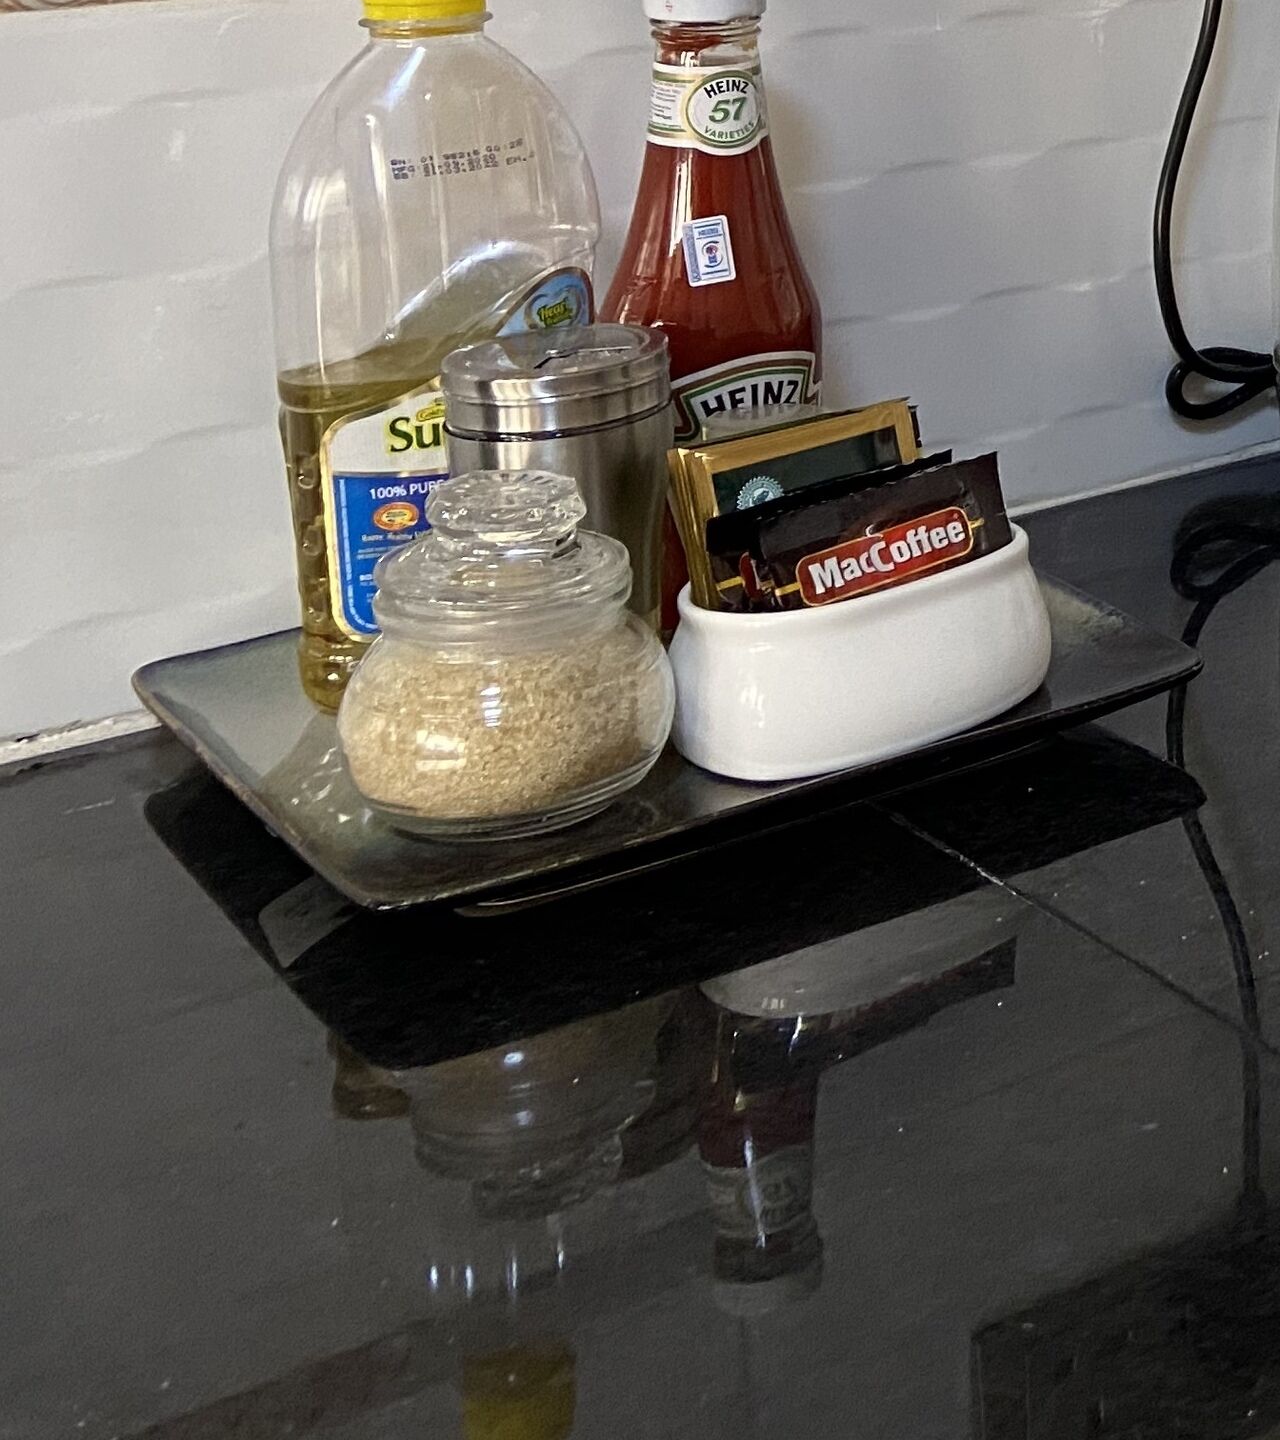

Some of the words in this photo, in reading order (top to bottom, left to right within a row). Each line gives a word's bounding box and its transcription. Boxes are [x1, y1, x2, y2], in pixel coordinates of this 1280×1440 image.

[704, 79, 749, 99] HEINZ
[708, 97, 746, 123] 57
[704, 121, 754, 140] VARIETIES
[700, 379, 799, 418] HEINZ
[369, 485, 407, 500] 100%
[808, 520, 966, 595] MacCoffee
